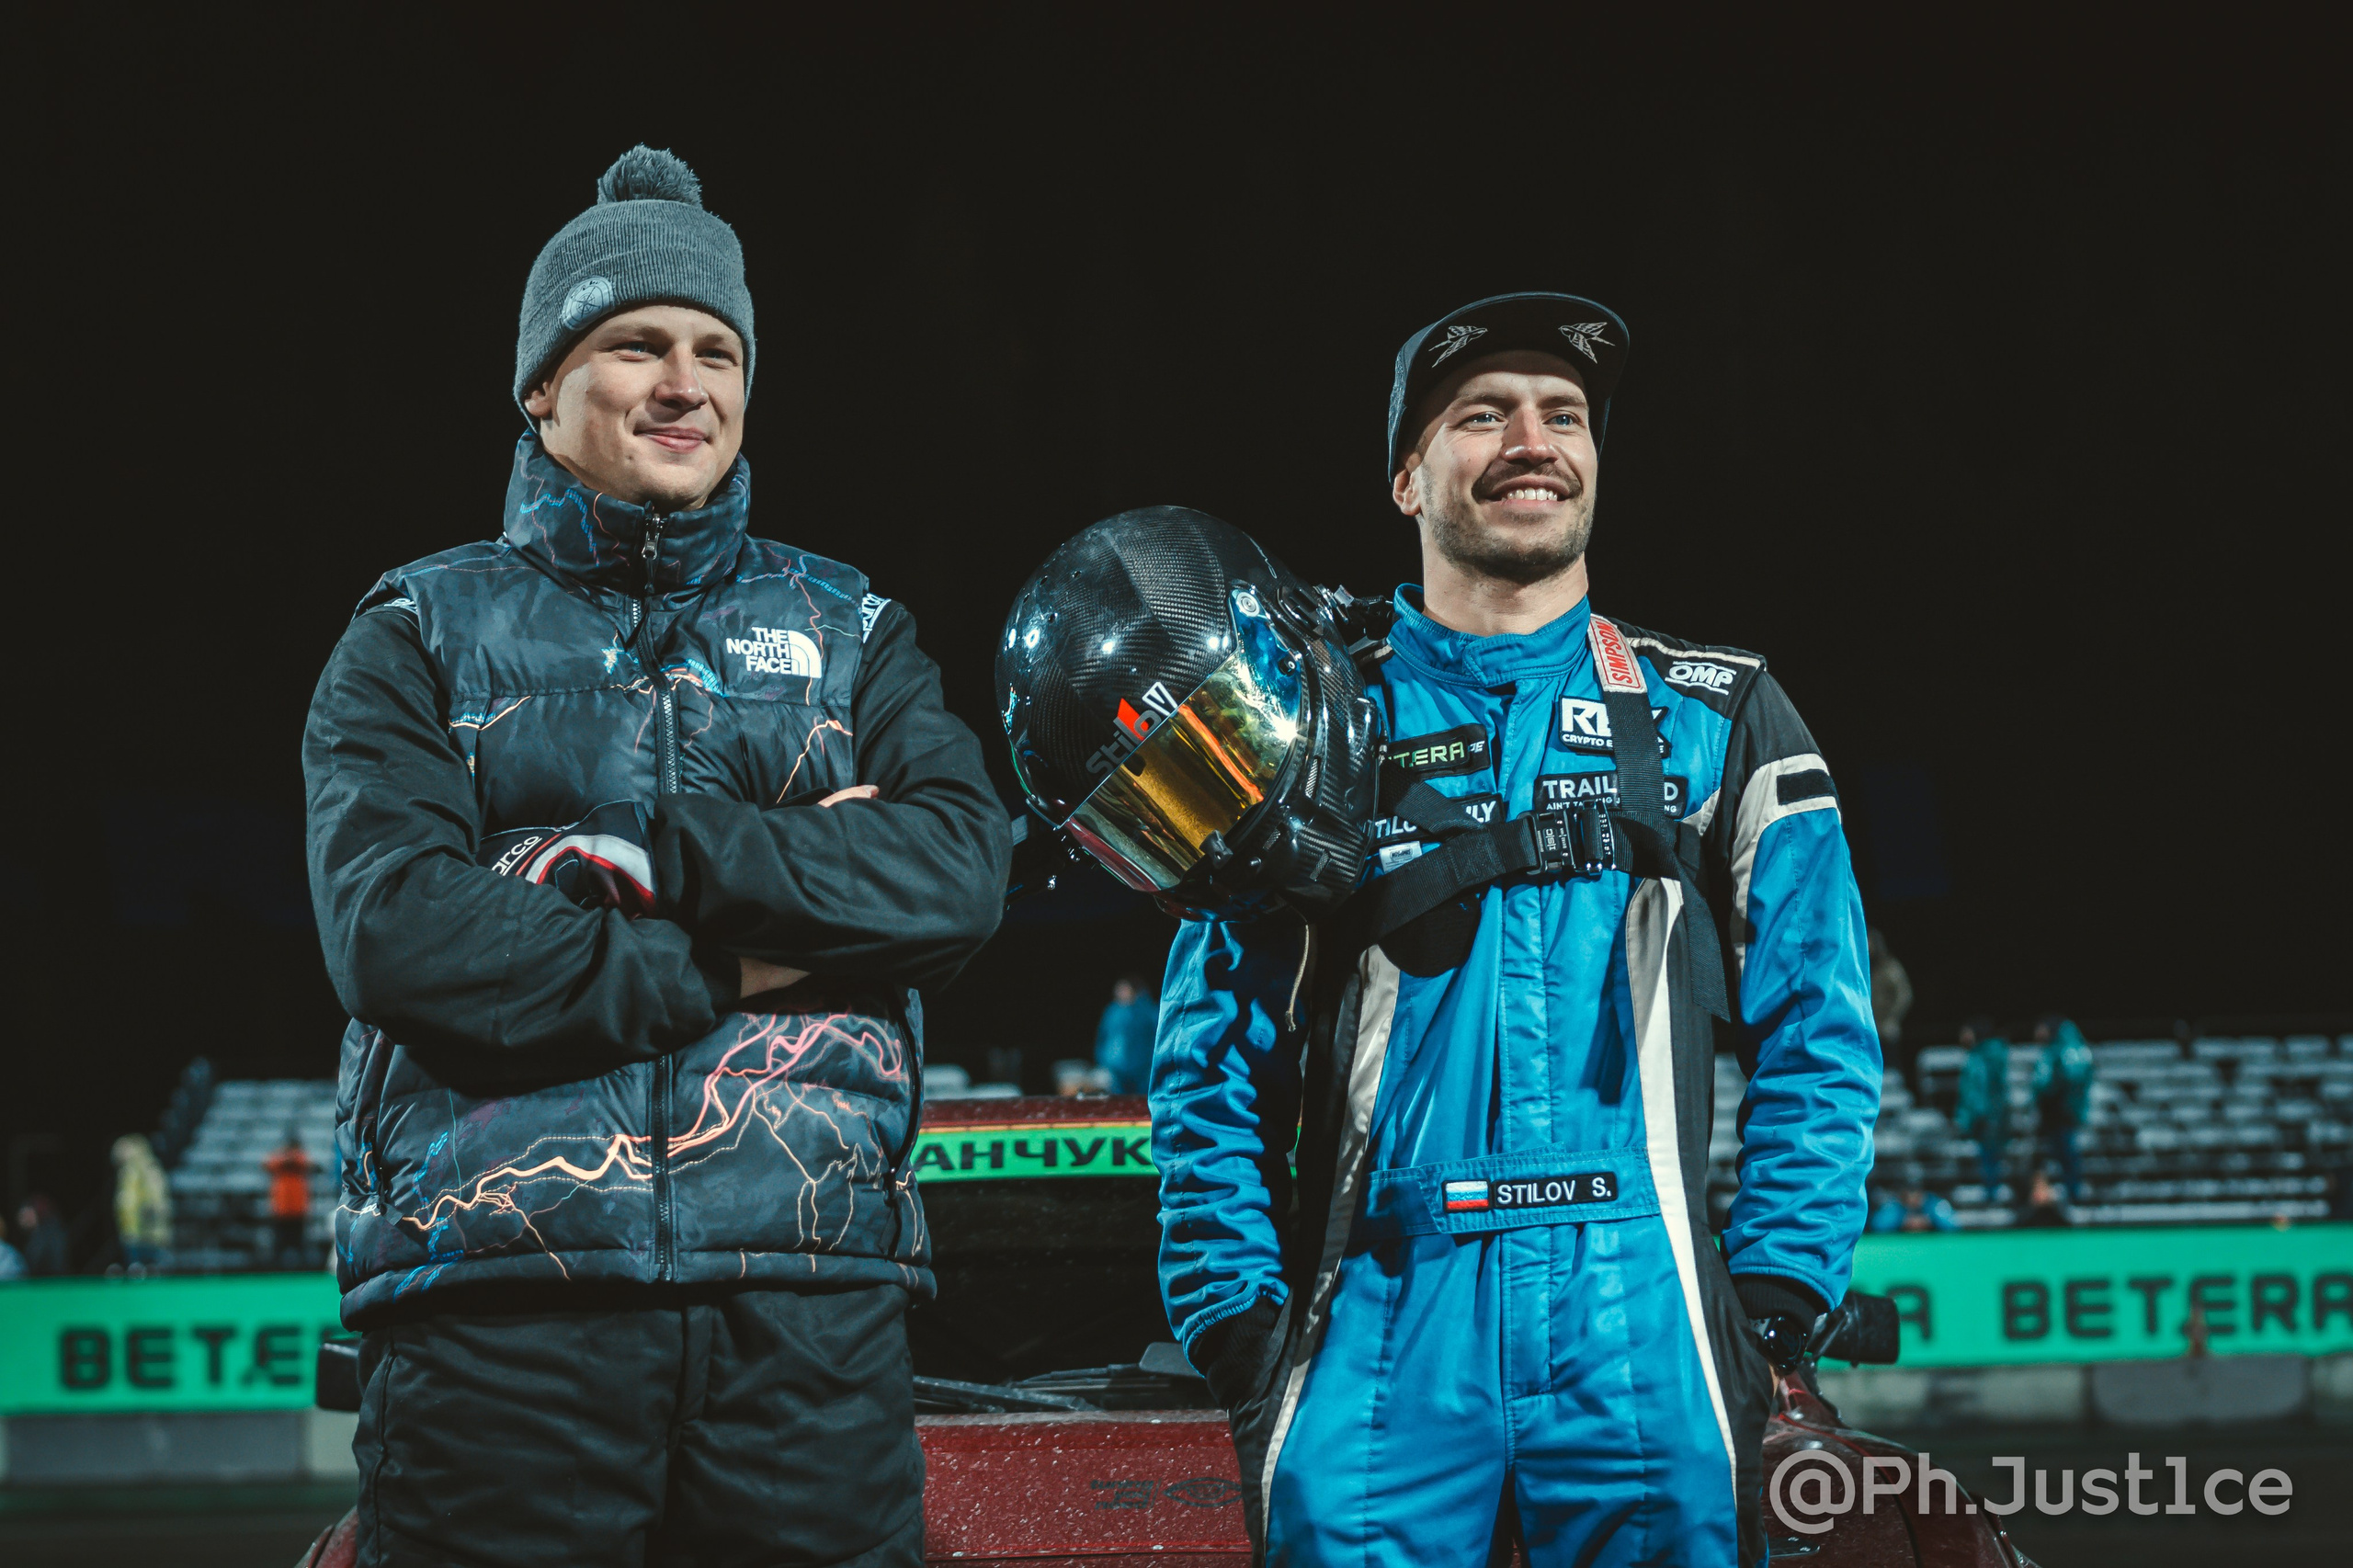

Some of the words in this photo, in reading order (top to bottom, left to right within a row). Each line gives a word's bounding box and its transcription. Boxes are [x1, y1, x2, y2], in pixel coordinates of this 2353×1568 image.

[751, 626, 790, 643] THE
[725, 638, 790, 659] NORTH
[1595, 620, 1633, 685] SIMPSON
[745, 655, 792, 675] FACE
[1668, 665, 1733, 687] OMP
[1562, 733, 1605, 747] CRYPTO
[1389, 741, 1465, 768] TERA
[491, 835, 540, 875] arco
[913, 1136, 1153, 1171] АНЧУК
[1496, 1180, 1576, 1205] STILOV
[1591, 1176, 1612, 1198] S.
[59, 1324, 358, 1392] BETE
